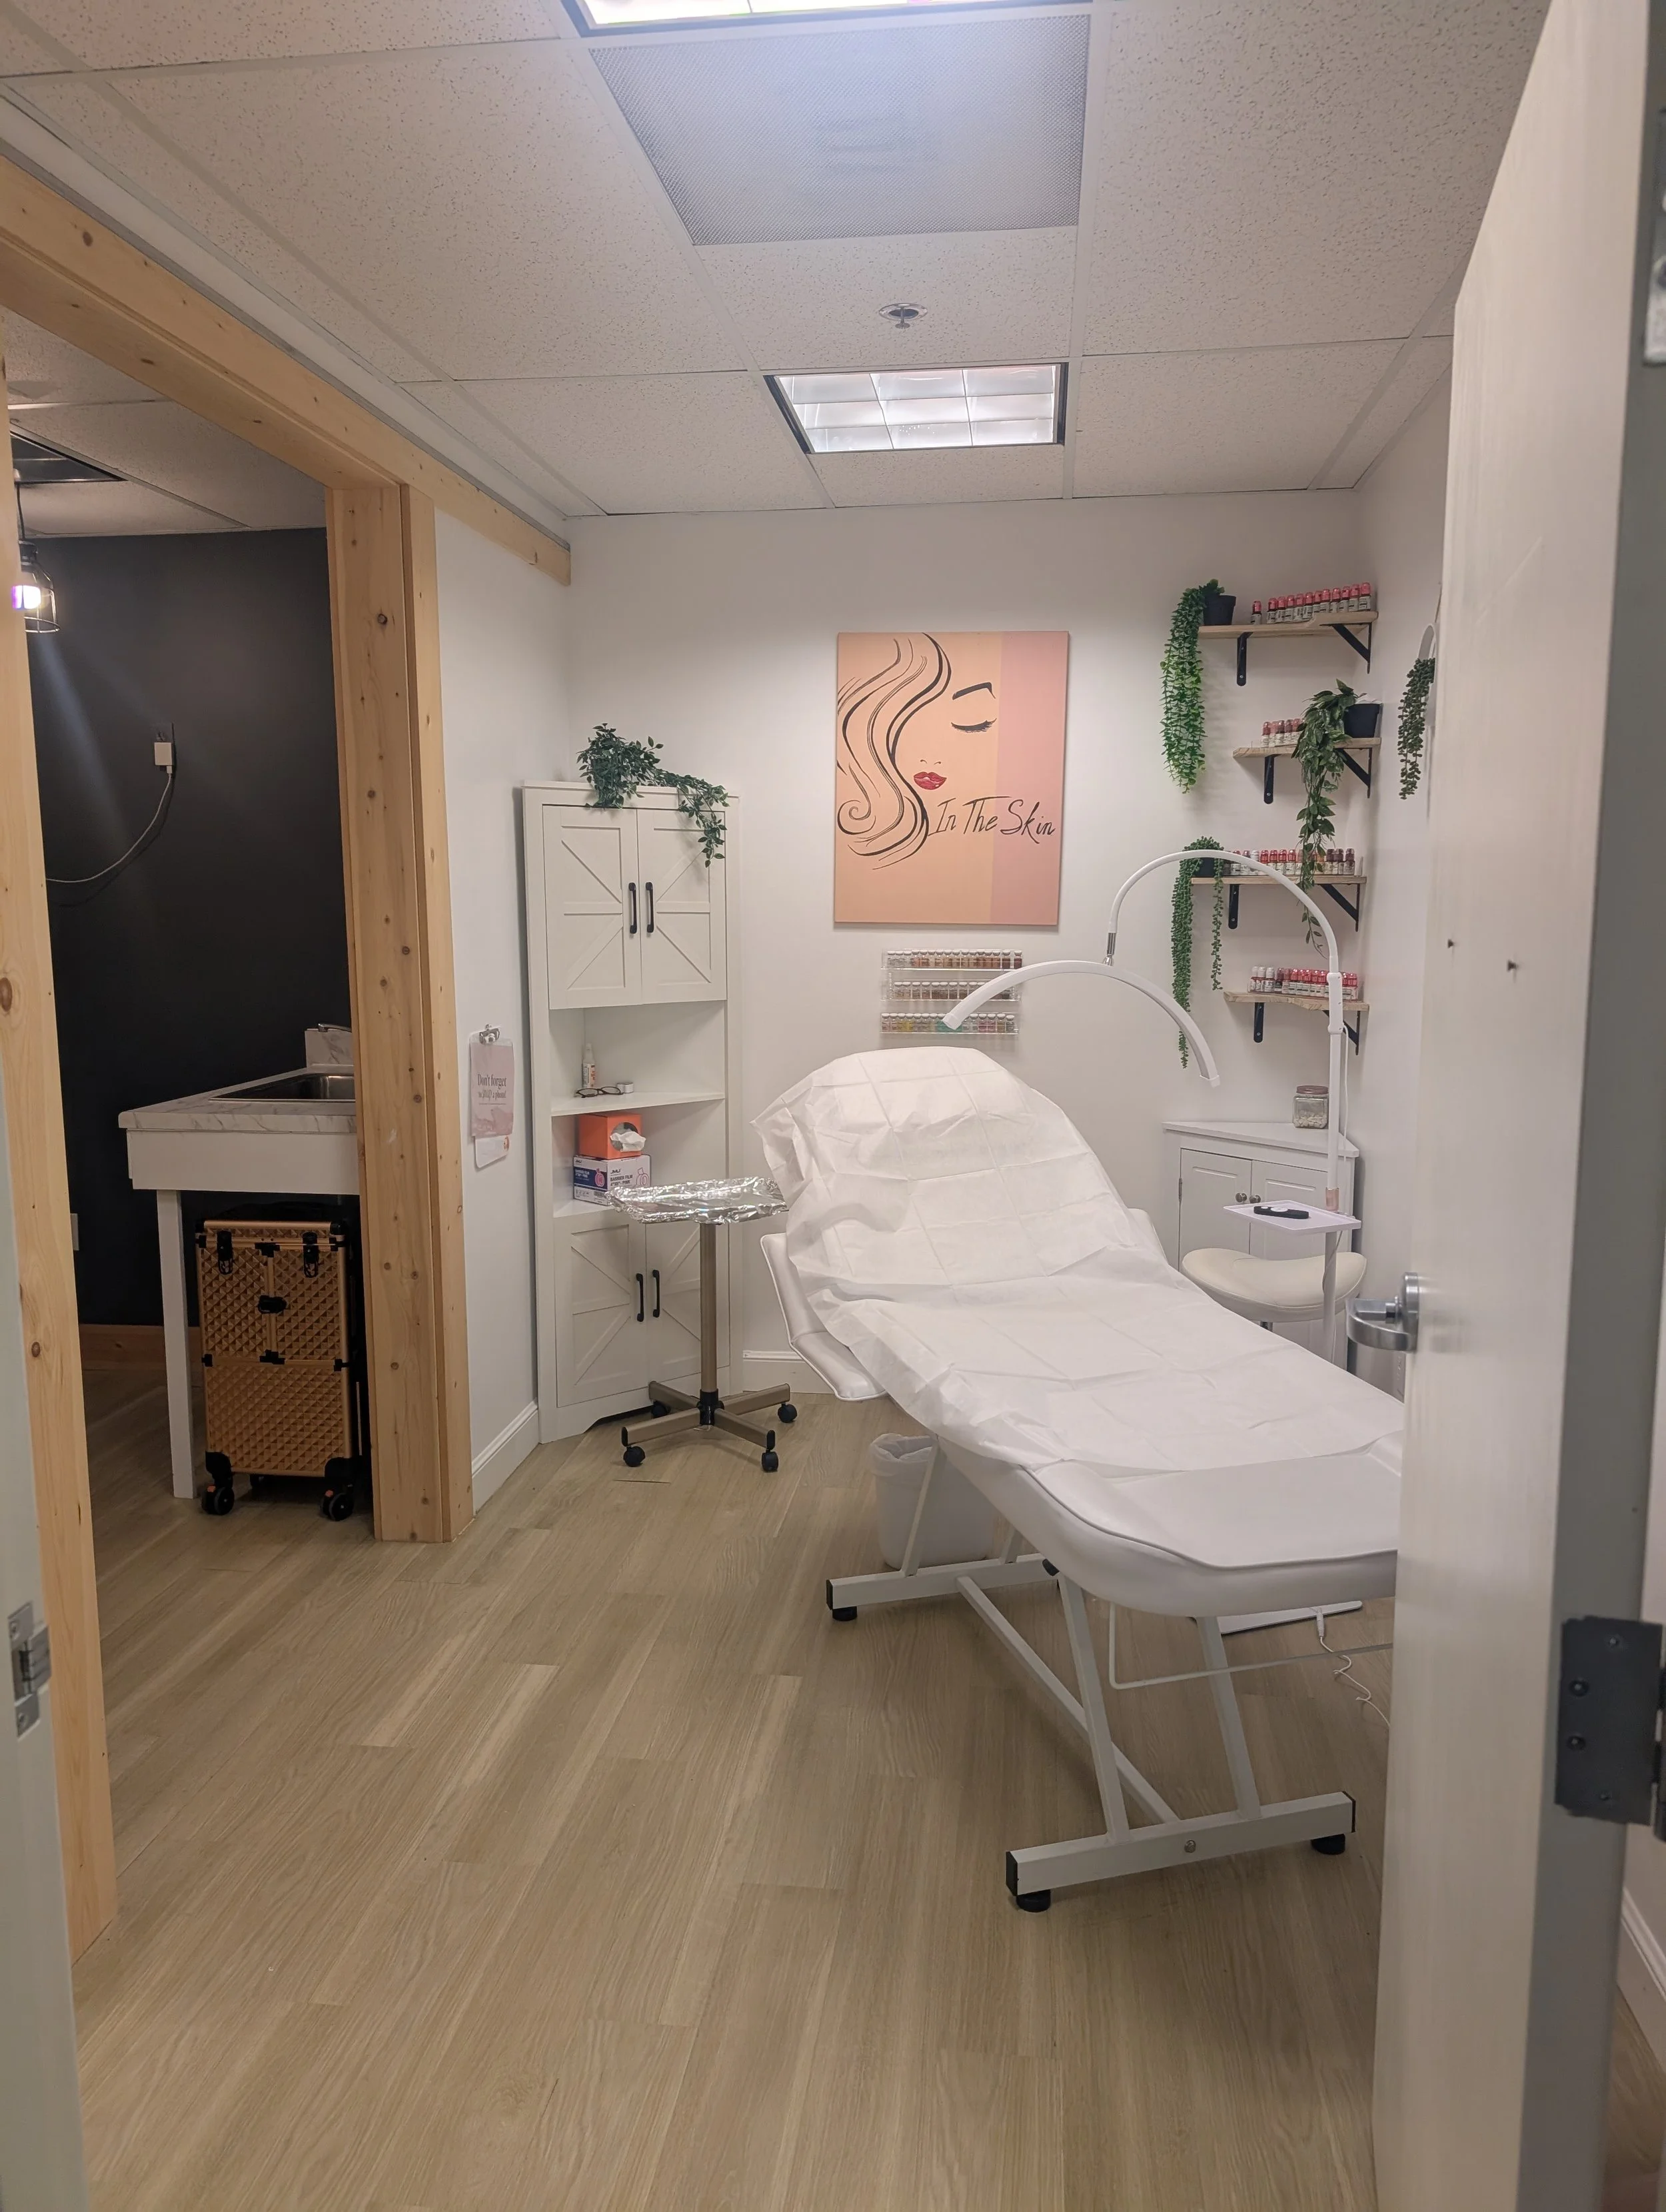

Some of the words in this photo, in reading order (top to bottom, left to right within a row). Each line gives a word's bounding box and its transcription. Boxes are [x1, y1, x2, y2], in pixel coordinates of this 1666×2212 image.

[928, 798, 956, 836] In
[962, 796, 1012, 834] The
[1000, 799, 1056, 844] Skin
[477, 1073, 490, 1086] Don't
[490, 1073, 506, 1089] forget
